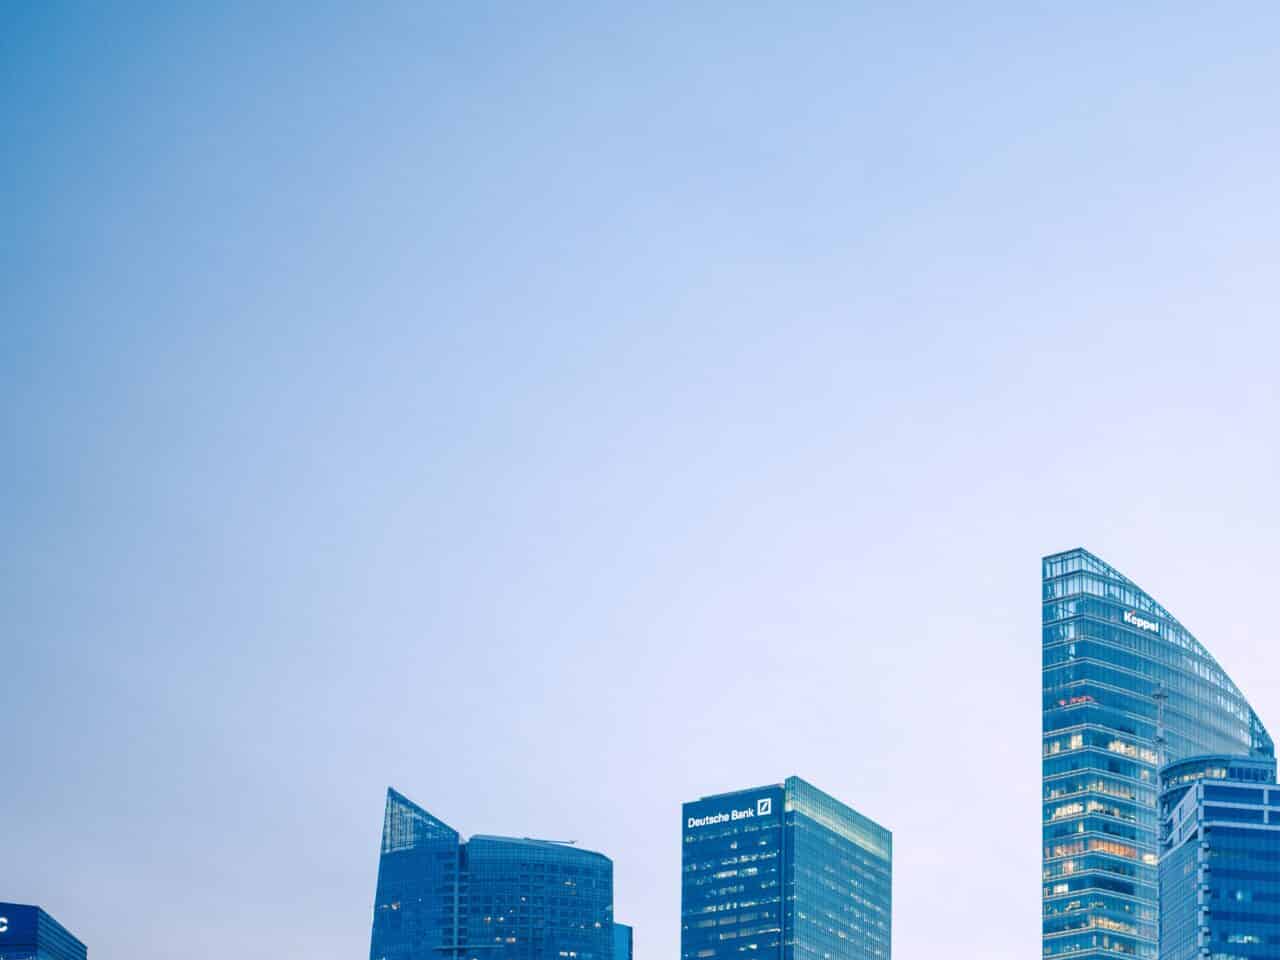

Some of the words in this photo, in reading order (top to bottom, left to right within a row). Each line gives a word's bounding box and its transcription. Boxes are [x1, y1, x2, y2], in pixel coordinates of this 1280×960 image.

[1123, 610, 1159, 632] Keppel
[687, 812, 730, 829] Deutsche
[731, 807, 755, 821] Bank
